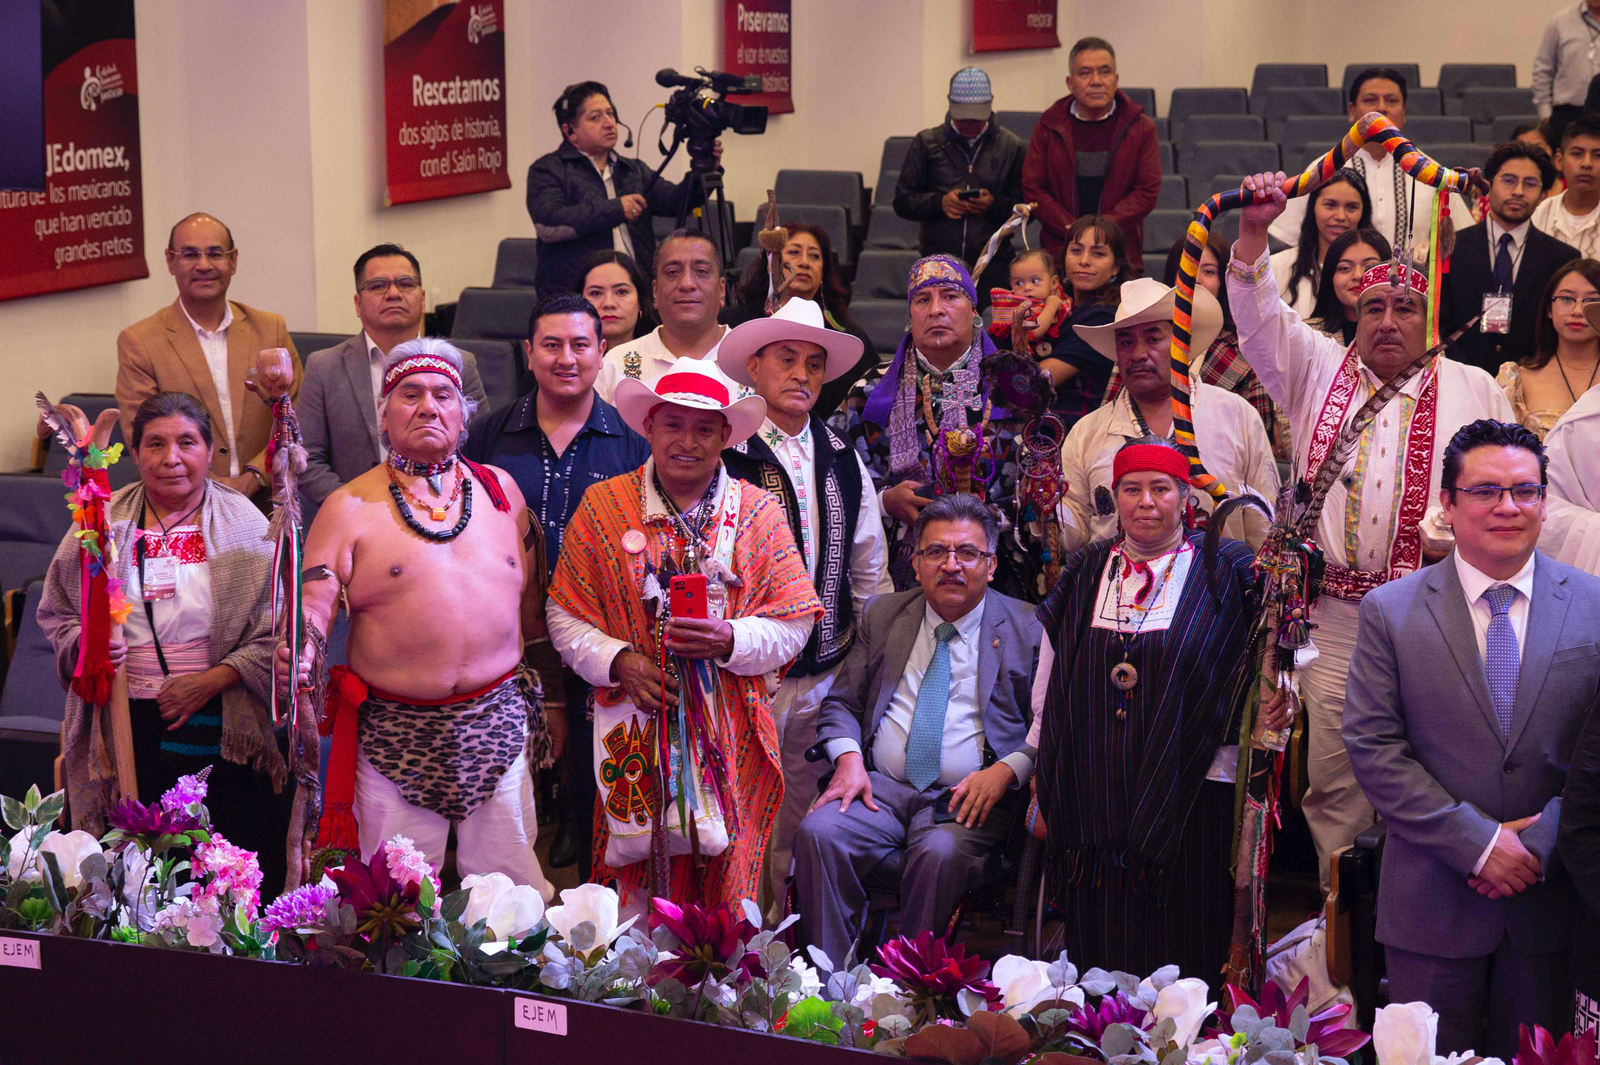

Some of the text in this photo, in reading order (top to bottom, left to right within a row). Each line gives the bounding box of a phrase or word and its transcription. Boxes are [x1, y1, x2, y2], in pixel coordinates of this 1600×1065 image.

[412, 74, 500, 107] Rescatamos
[398, 120, 420, 146] dos
[420, 119, 450, 149] siglos
[450, 117, 464, 141] de
[420, 156, 440, 178] con
[440, 150, 451, 175] el
[477, 146, 502, 174] Rojo
[49, 182, 66, 204] los
[67, 178, 132, 202] mexicanos
[34, 204, 133, 242] que han vencido
[54, 236, 134, 270] grandes retos
[3, 943, 35, 959] EJEM
[522, 1004, 558, 1030] EJEM
